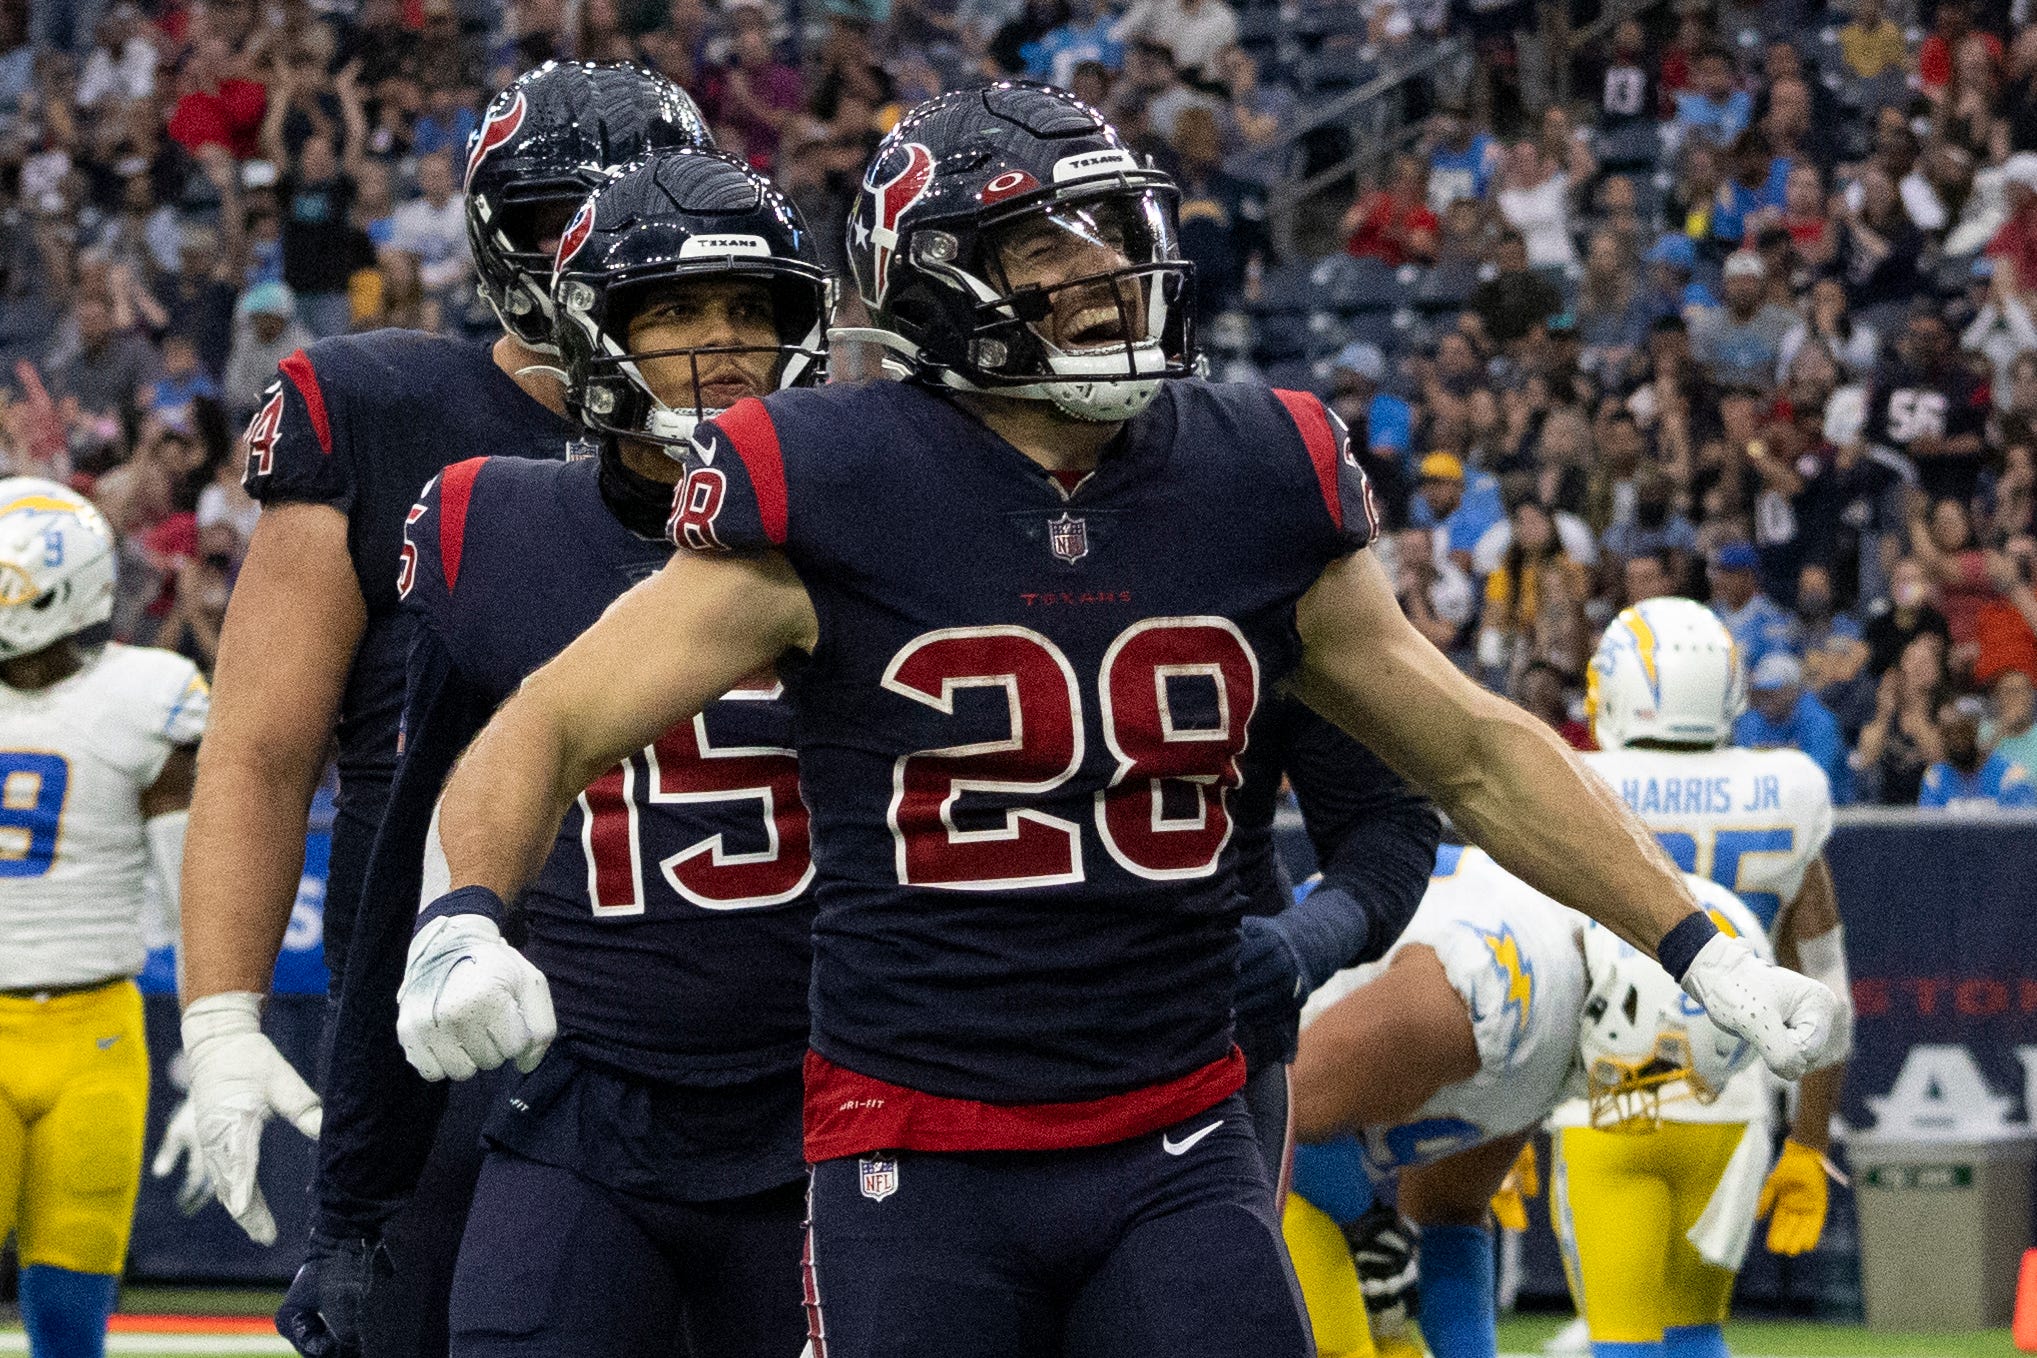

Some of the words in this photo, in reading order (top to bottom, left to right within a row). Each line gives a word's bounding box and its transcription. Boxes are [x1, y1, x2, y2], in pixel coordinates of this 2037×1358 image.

[1069, 155, 1123, 169] TEXANS
[1020, 592, 1131, 606] TEXANS
[881, 615, 1260, 890] 28
[577, 680, 817, 917] 15
[1622, 776, 1730, 814] HARRIS
[1743, 774, 1781, 812] JR
[866, 1174, 891, 1192] NFL
